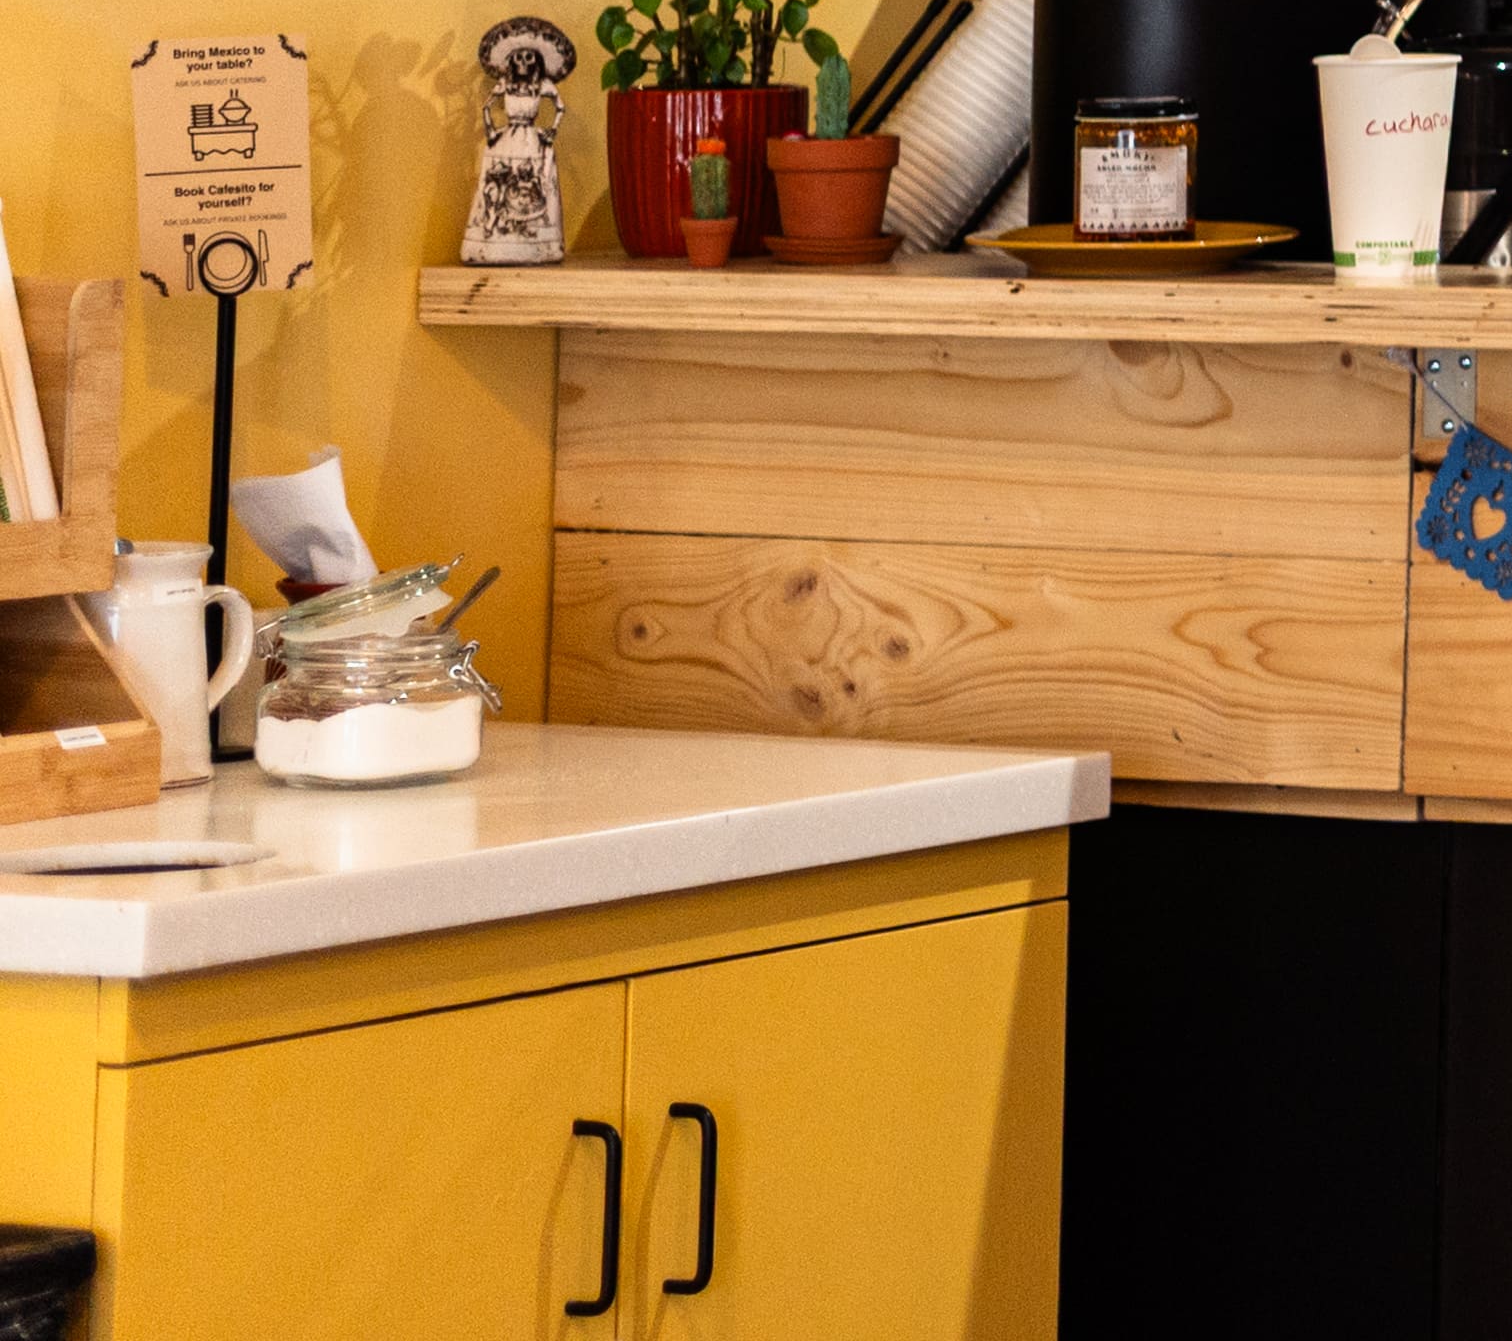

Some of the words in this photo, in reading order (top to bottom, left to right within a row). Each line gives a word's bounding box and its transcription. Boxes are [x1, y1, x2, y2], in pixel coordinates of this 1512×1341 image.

[173, 48, 206, 60] Bring
[209, 46, 250, 57] Mexico
[253, 46, 265, 56] to
[187, 61, 213, 73] your
[216, 59, 253, 70] table?
[174, 185, 204, 197] Book
[208, 184, 256, 195] Cafesito
[259, 182, 275, 192] for
[198, 196, 253, 210] yourself?
